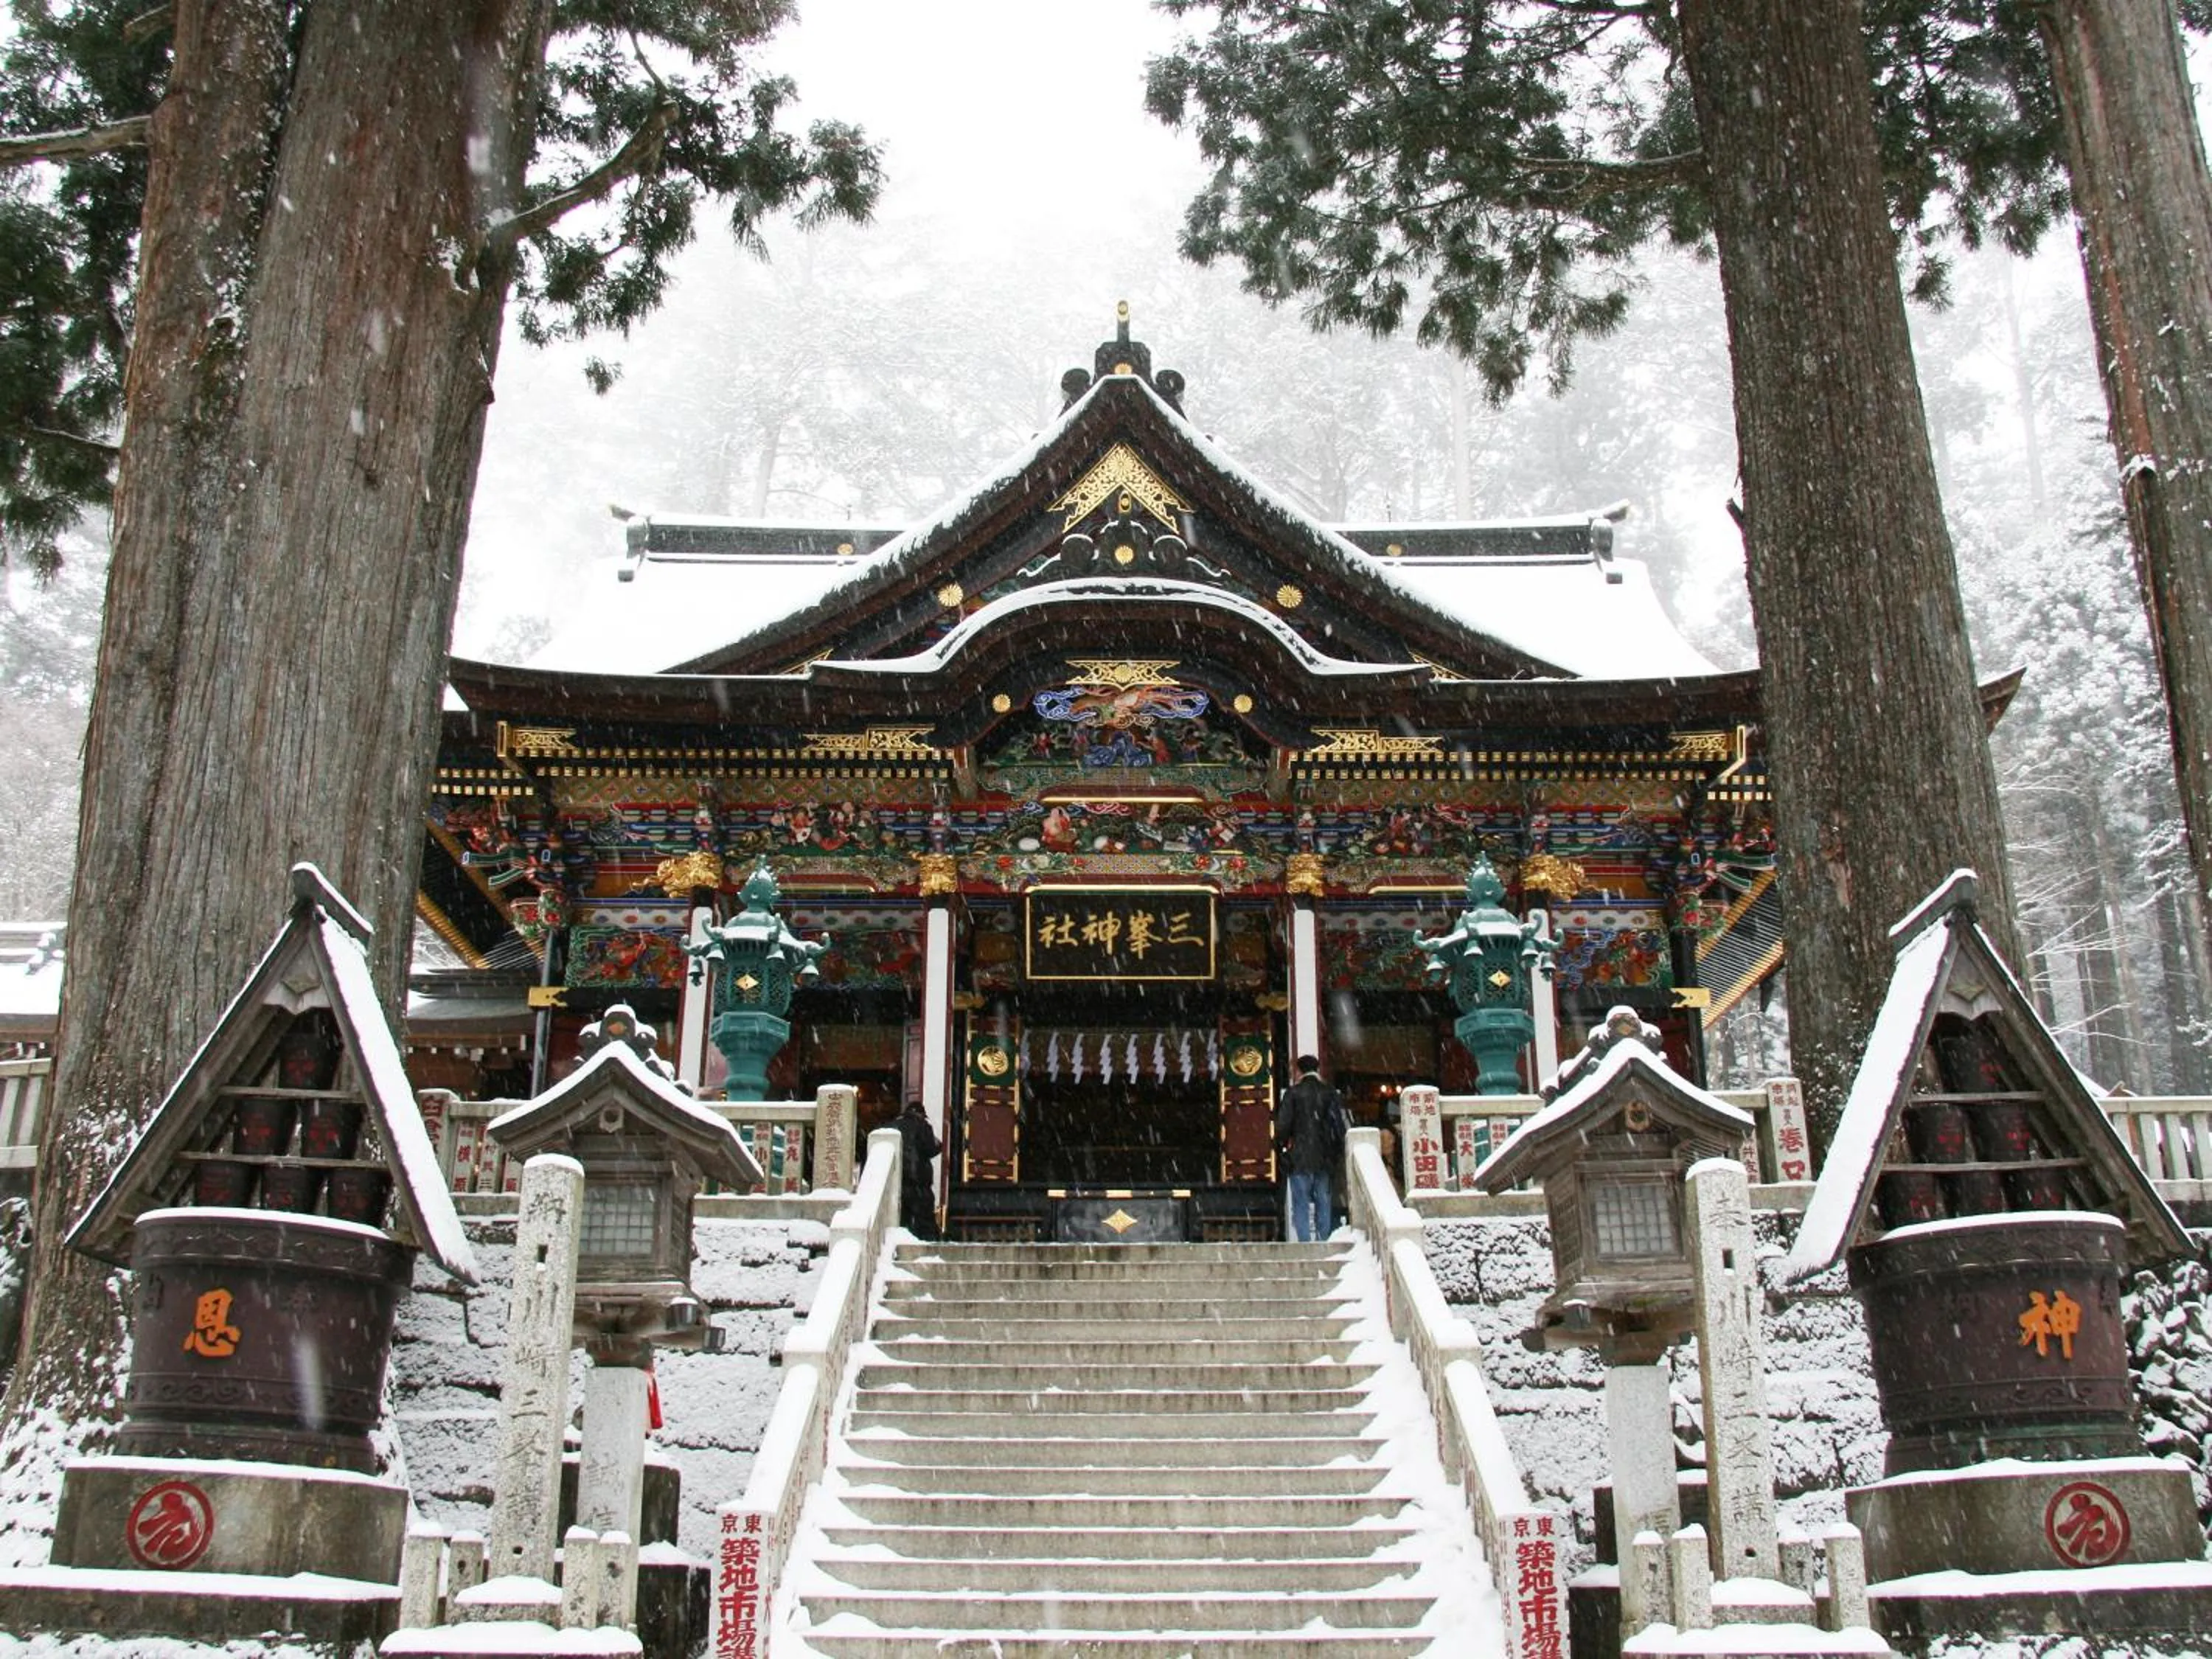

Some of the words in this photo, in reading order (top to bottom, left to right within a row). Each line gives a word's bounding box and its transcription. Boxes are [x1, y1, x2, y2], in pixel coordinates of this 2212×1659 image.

[1038, 910, 1205, 959] 三峯神社
[2018, 1290, 2082, 1359] 神
[721, 1514, 762, 1534] 東京
[1514, 1516, 1555, 1537] 東京
